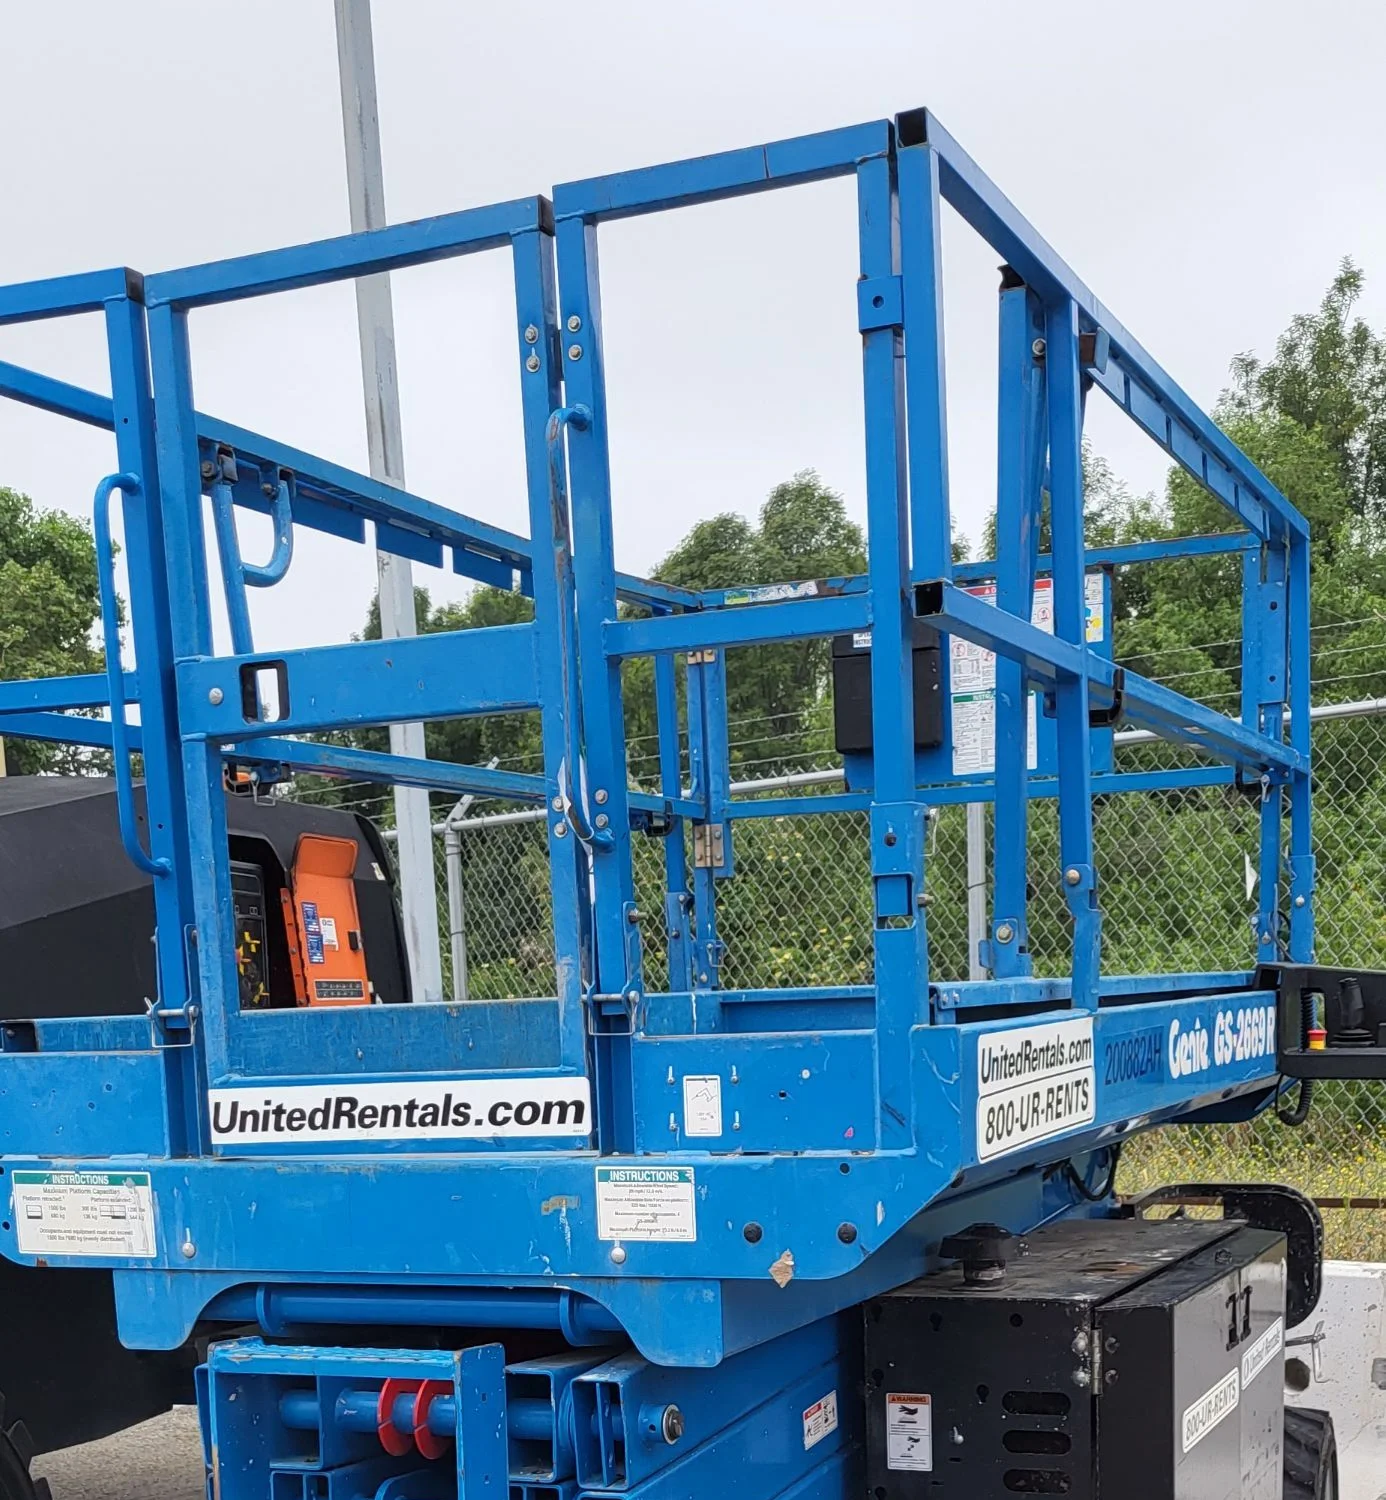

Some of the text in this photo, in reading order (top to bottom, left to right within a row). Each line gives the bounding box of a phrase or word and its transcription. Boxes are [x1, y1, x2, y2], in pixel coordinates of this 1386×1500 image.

[981, 1034, 1092, 1084] UnitedRentals.com
[1104, 1032, 1162, 1085] 200882AH
[1168, 1017, 1208, 1079] Genie
[1214, 1007, 1265, 1066] GS-2669
[213, 1093, 585, 1133] UnitedRentals.com
[985, 1077, 1089, 1145] 800-UR-RENTS
[52, 1173, 109, 1185] INSTRUCTIONS
[609, 1170, 679, 1181] INSTRUCTIONS
[1185, 1379, 1238, 1442] 800-UR-RENTS
